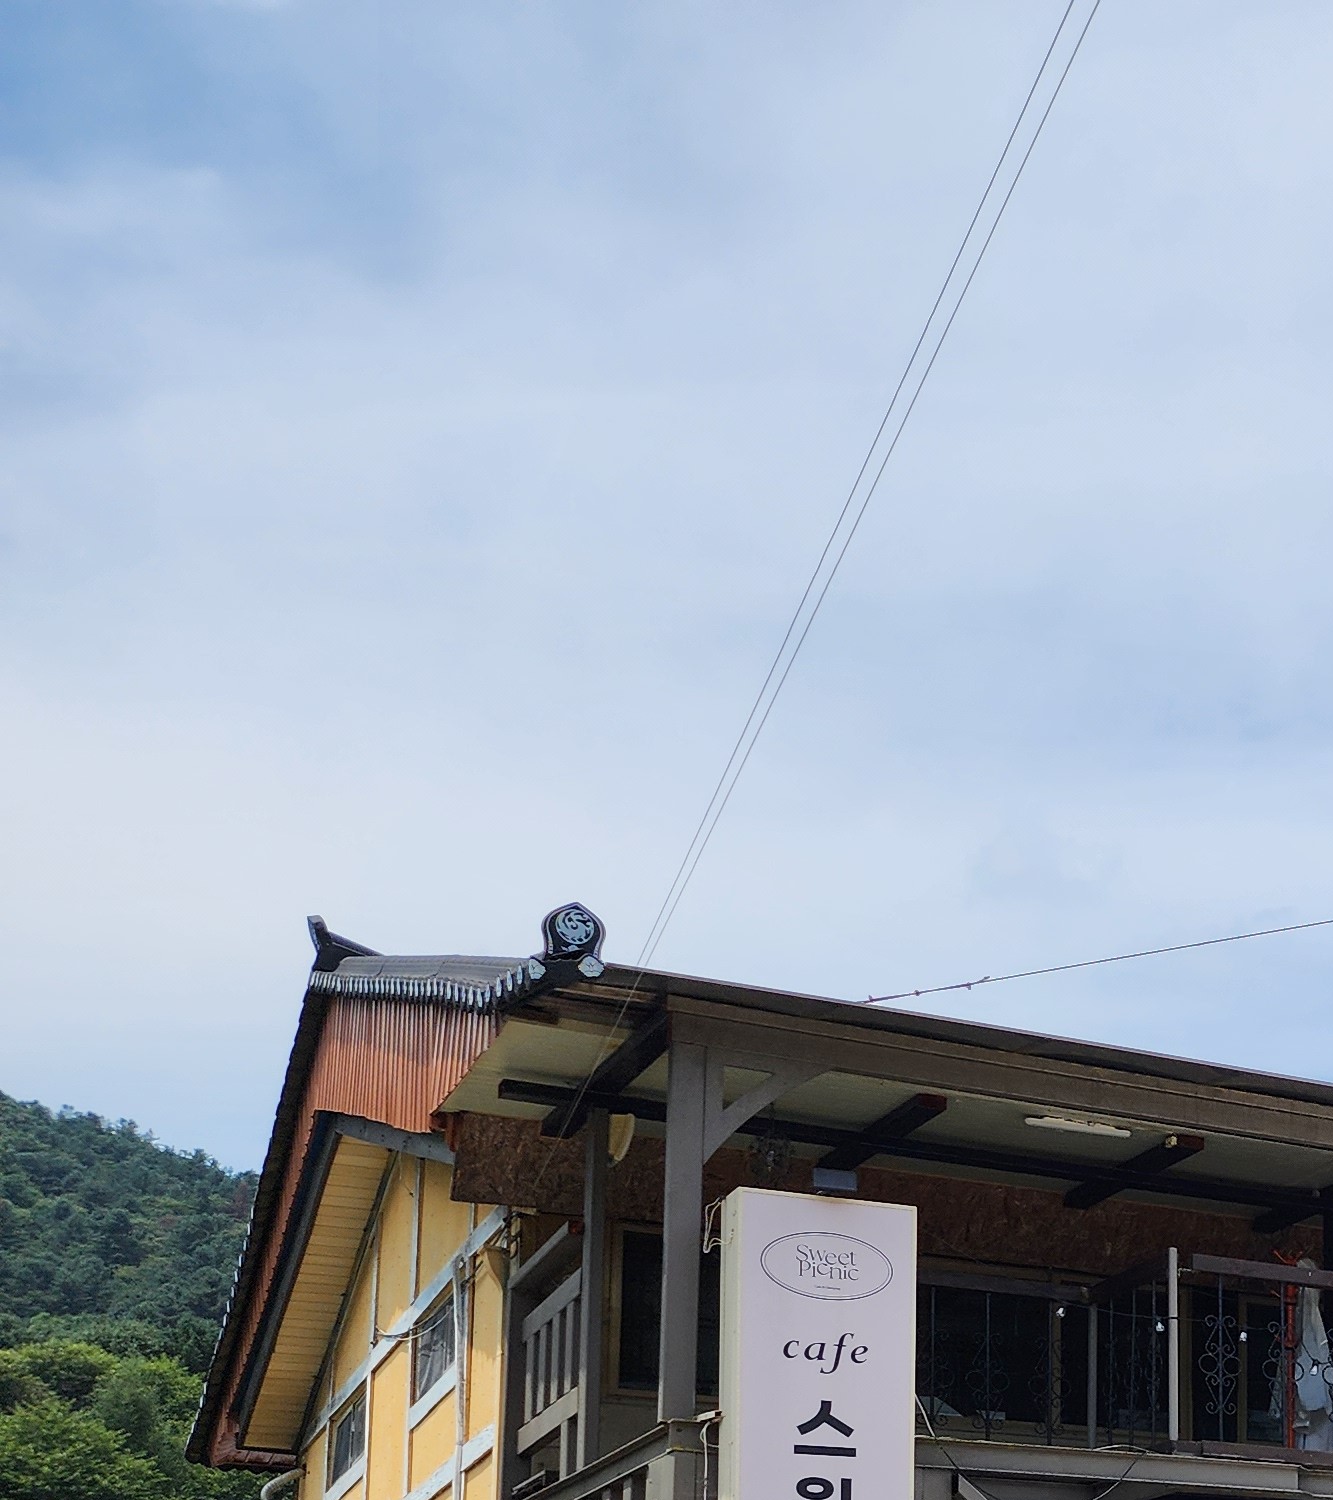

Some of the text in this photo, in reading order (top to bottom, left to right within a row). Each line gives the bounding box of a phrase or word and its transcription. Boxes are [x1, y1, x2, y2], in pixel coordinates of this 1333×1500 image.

[796, 1244, 857, 1266] Sweet
[797, 1260, 859, 1281] Picnic
[783, 1332, 869, 1375] cafe
